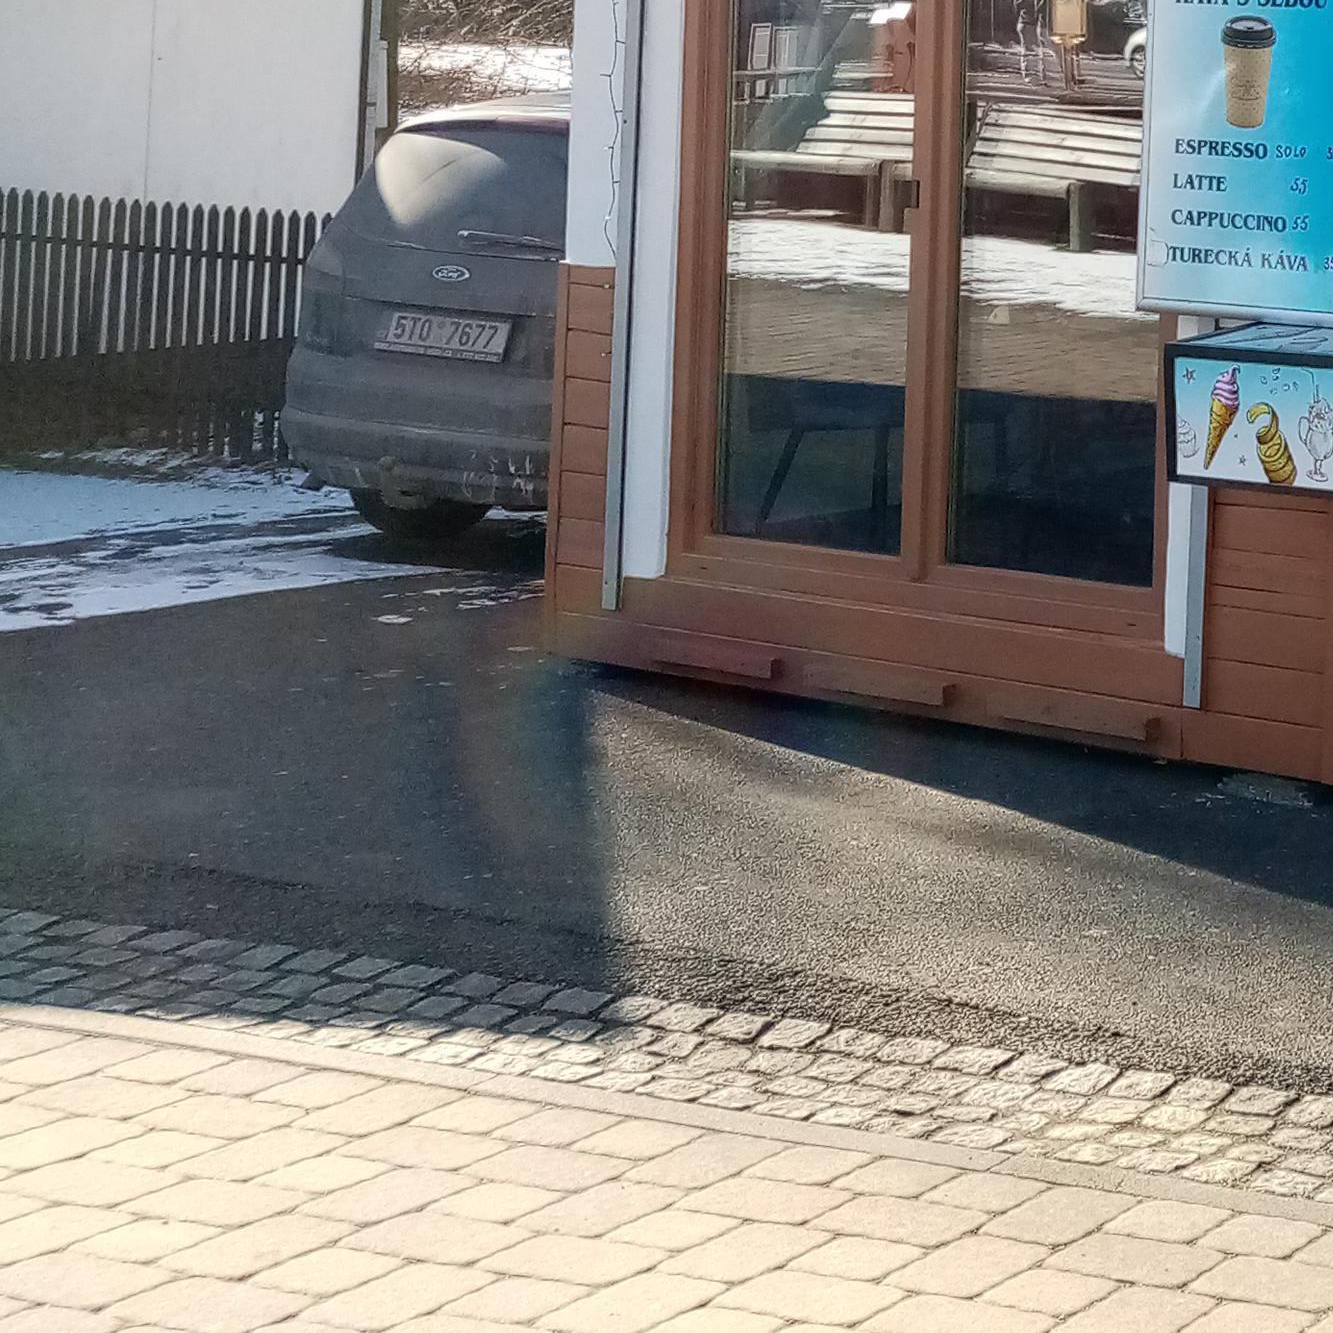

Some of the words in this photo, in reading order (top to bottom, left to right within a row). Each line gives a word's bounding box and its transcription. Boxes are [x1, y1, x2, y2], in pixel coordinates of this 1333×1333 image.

[1175, 138, 1268, 159] ESPRESSO
[1172, 173, 1228, 192] LATTE
[1171, 209, 1287, 232] CAPPUCCINO
[1291, 215, 1310, 231] 55
[1169, 246, 1253, 267] TURECKÁ
[1261, 249, 1309, 272] KÁVA
[445, 321, 498, 349] 7677
